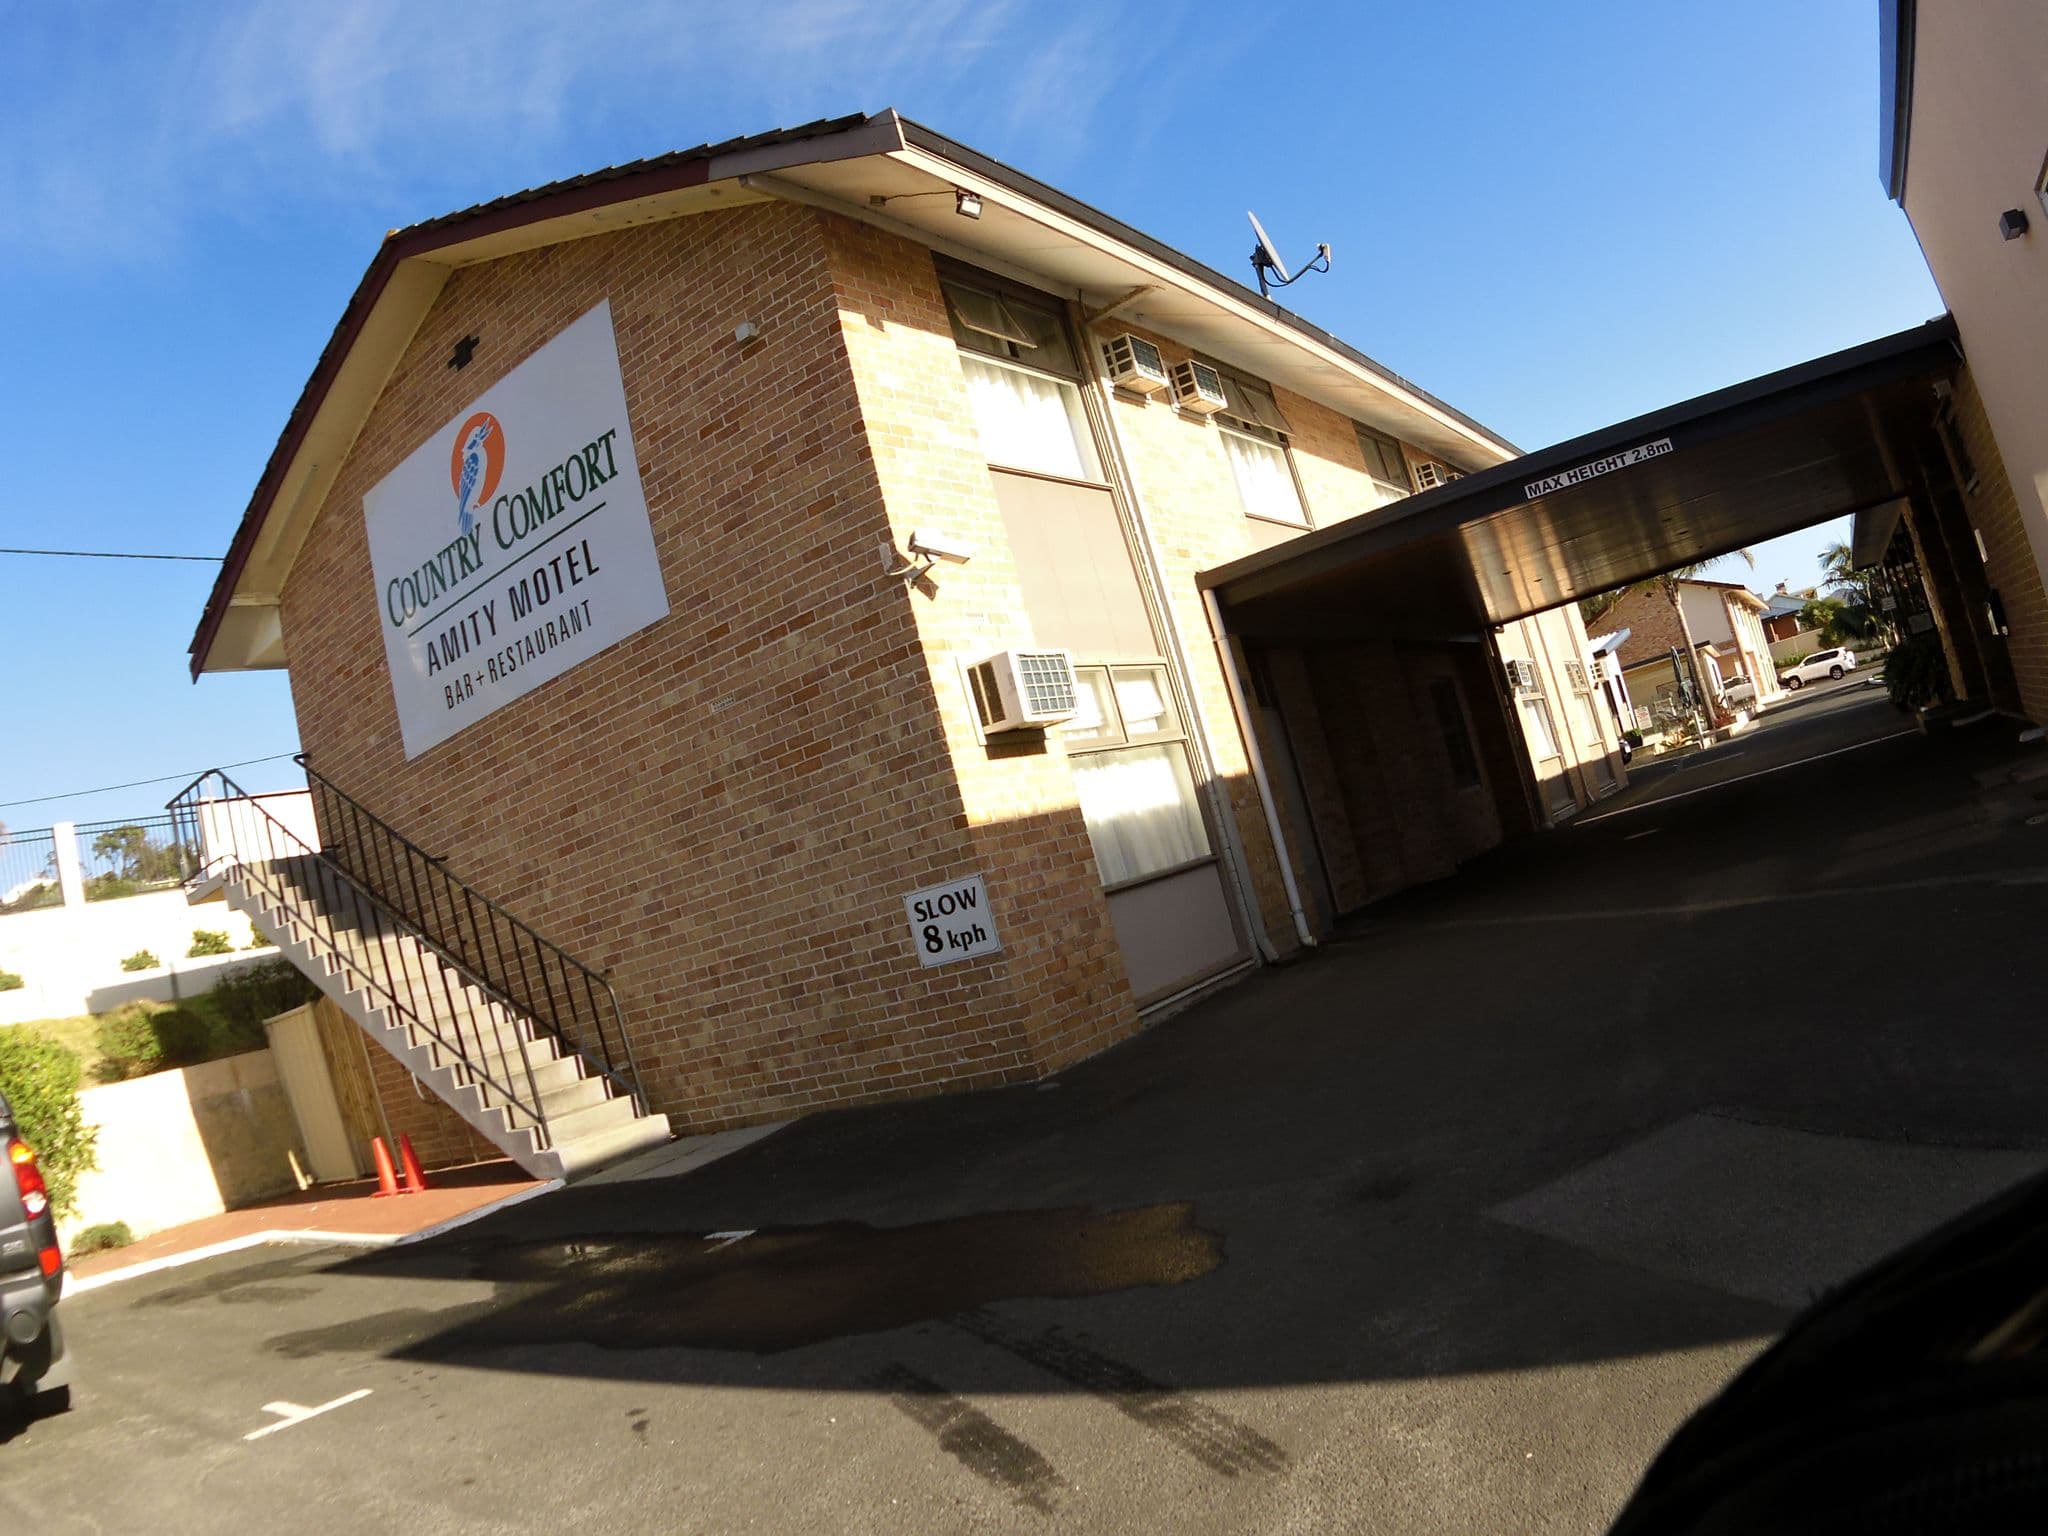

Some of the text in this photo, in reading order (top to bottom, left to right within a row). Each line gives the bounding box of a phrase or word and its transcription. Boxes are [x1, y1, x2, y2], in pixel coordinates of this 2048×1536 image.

[1527, 442, 1671, 497] MAX HEIGHT 2.8m
[387, 428, 618, 627] COUNTRY COMFORT
[427, 539, 599, 676] AMITY MOTEL
[914, 886, 976, 922] SLOW
[923, 924, 987, 953] 8 kph
